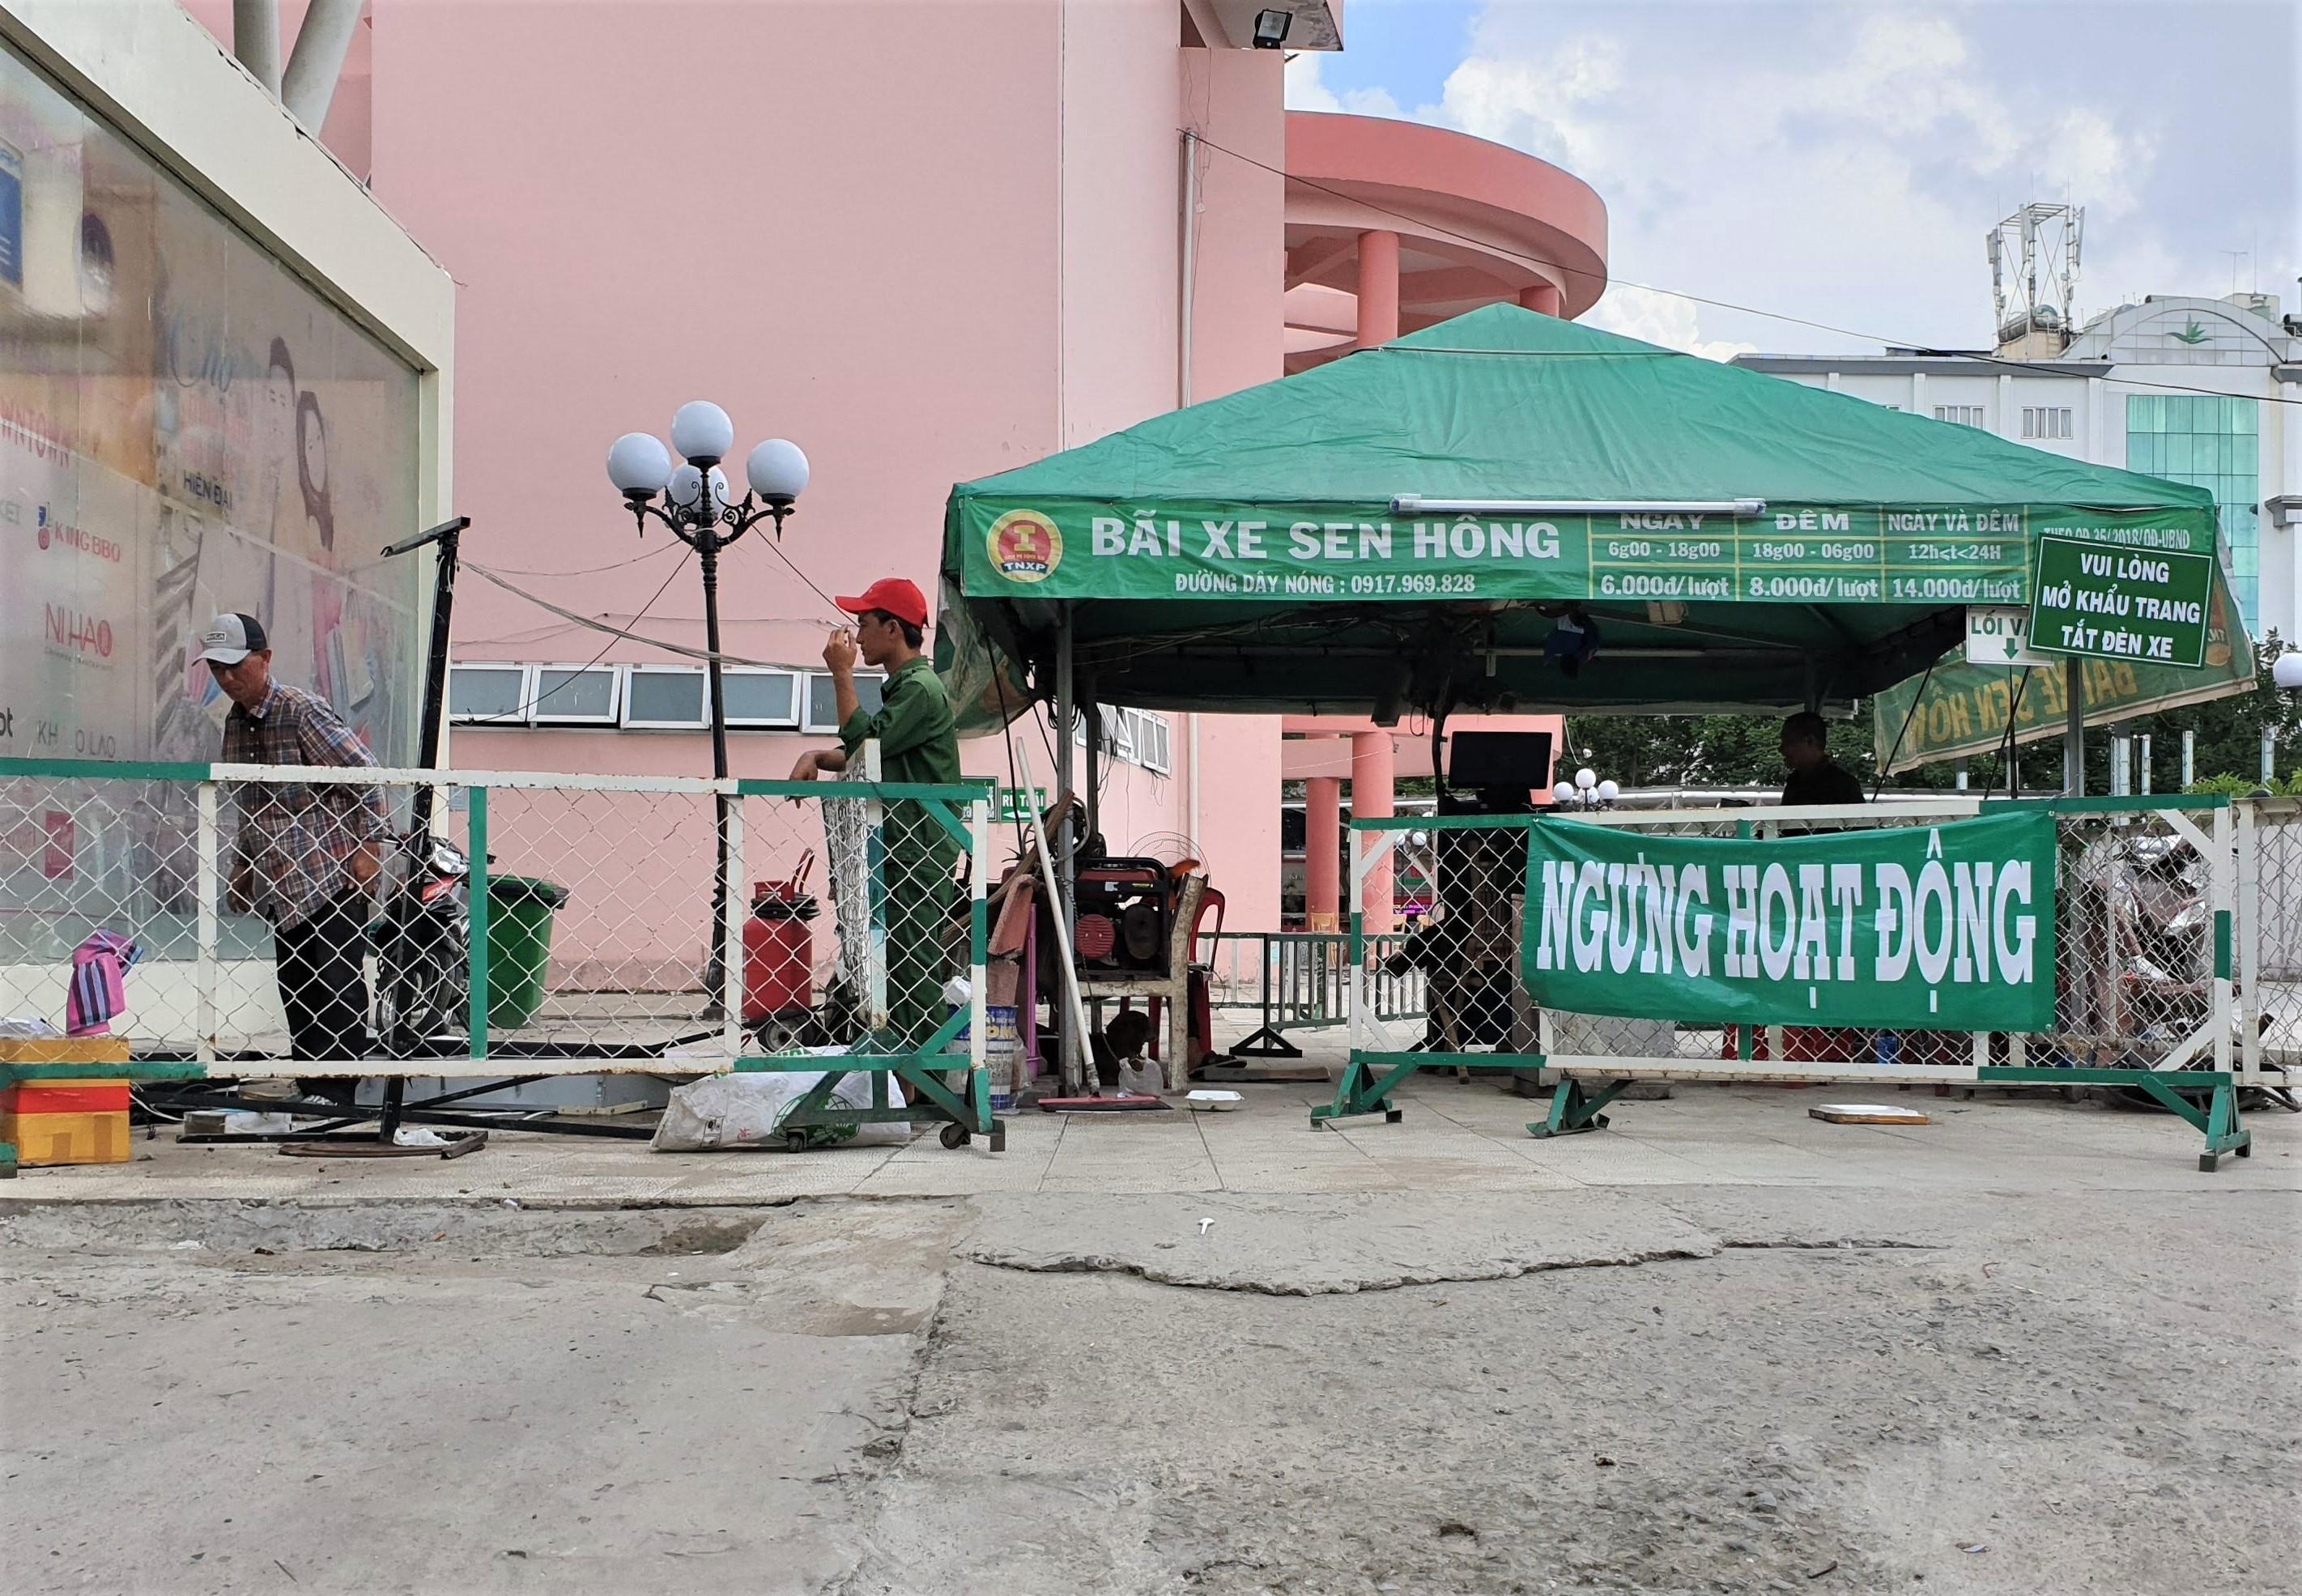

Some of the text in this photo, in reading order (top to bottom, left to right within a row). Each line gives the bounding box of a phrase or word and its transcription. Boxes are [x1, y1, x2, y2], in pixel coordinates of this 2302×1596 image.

[1775, 509, 1849, 530] ĐÊM
[1888, 509, 1939, 532] NGÀY
[1944, 509, 1969, 532] VÀ
[1976, 509, 2019, 532] ĐÊM
[1091, 509, 1181, 556] BÃI
[1201, 521, 1267, 559] XE
[1288, 521, 1392, 560] SEN
[1609, 541, 1651, 559] 6g00
[1669, 542, 1721, 560] 18g00
[1753, 543, 1805, 560] 18g00
[1822, 543, 1874, 561] 06g00
[1004, 561, 1046, 571] TNXP
[2081, 553, 2169, 584] VUI LÒNG
[1176, 569, 1237, 594] ĐƯỜNG
[1243, 570, 1279, 594] DÂY
[1285, 570, 1334, 594] NÓNG
[1351, 574, 1475, 594] 0917.969.828
[2042, 580, 2201, 624] MỞ KHẨU TRANG
[2010, 618, 2028, 636] V
[2062, 618, 2173, 658] TẮT ĐÈN XE
[1723, 862, 1862, 1010] HOẠT
[1874, 828, 2036, 1013] ĐỘNG
